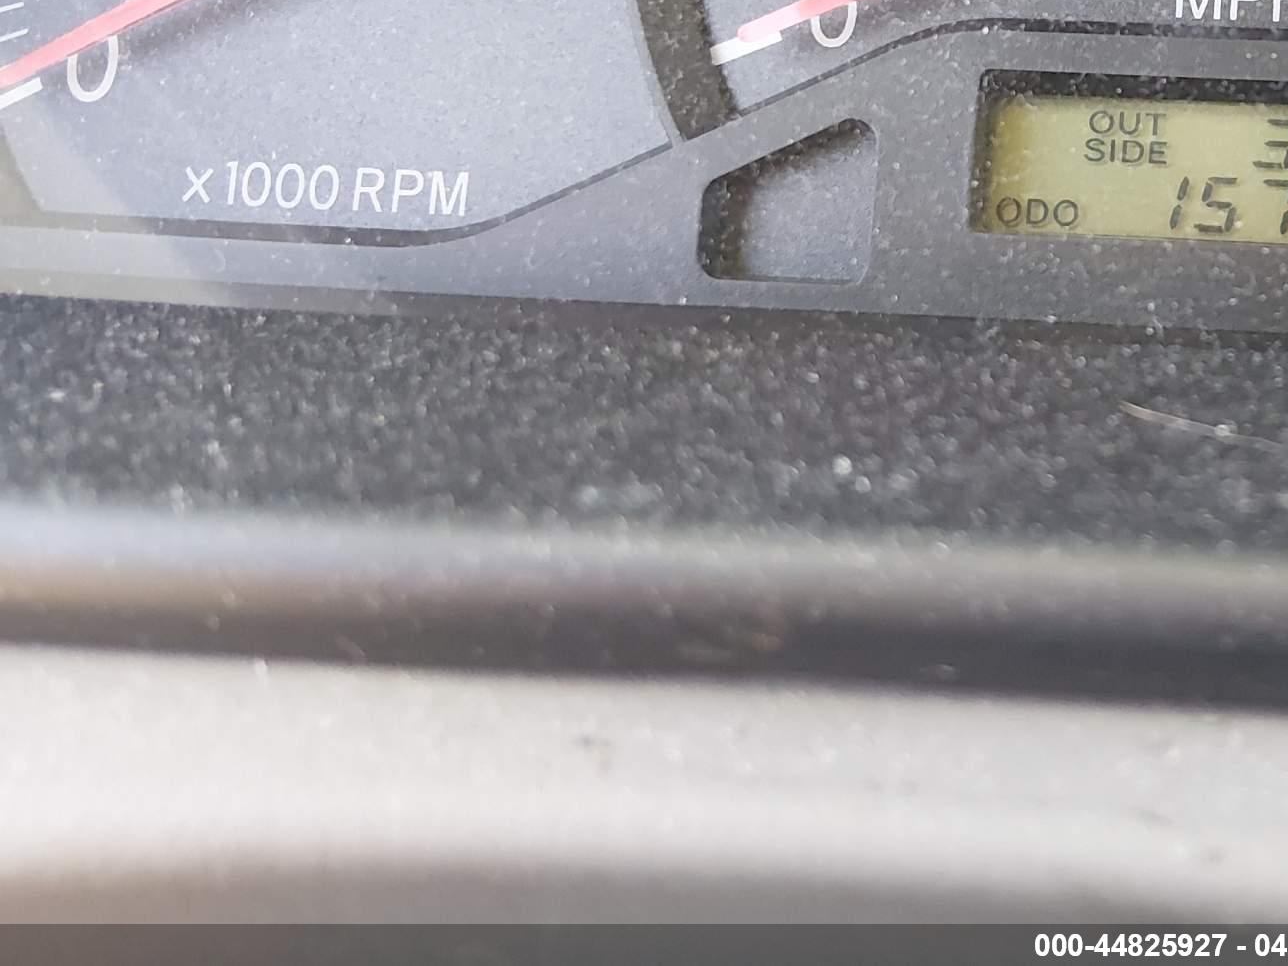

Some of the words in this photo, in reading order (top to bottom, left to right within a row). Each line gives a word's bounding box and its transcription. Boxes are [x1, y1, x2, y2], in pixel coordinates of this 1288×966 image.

[65, 34, 119, 102] 0
[1088, 110, 1167, 136] OUT
[1083, 140, 1168, 165] SIDE
[352, 169, 470, 216] RPM
[995, 197, 1079, 227] ODO
